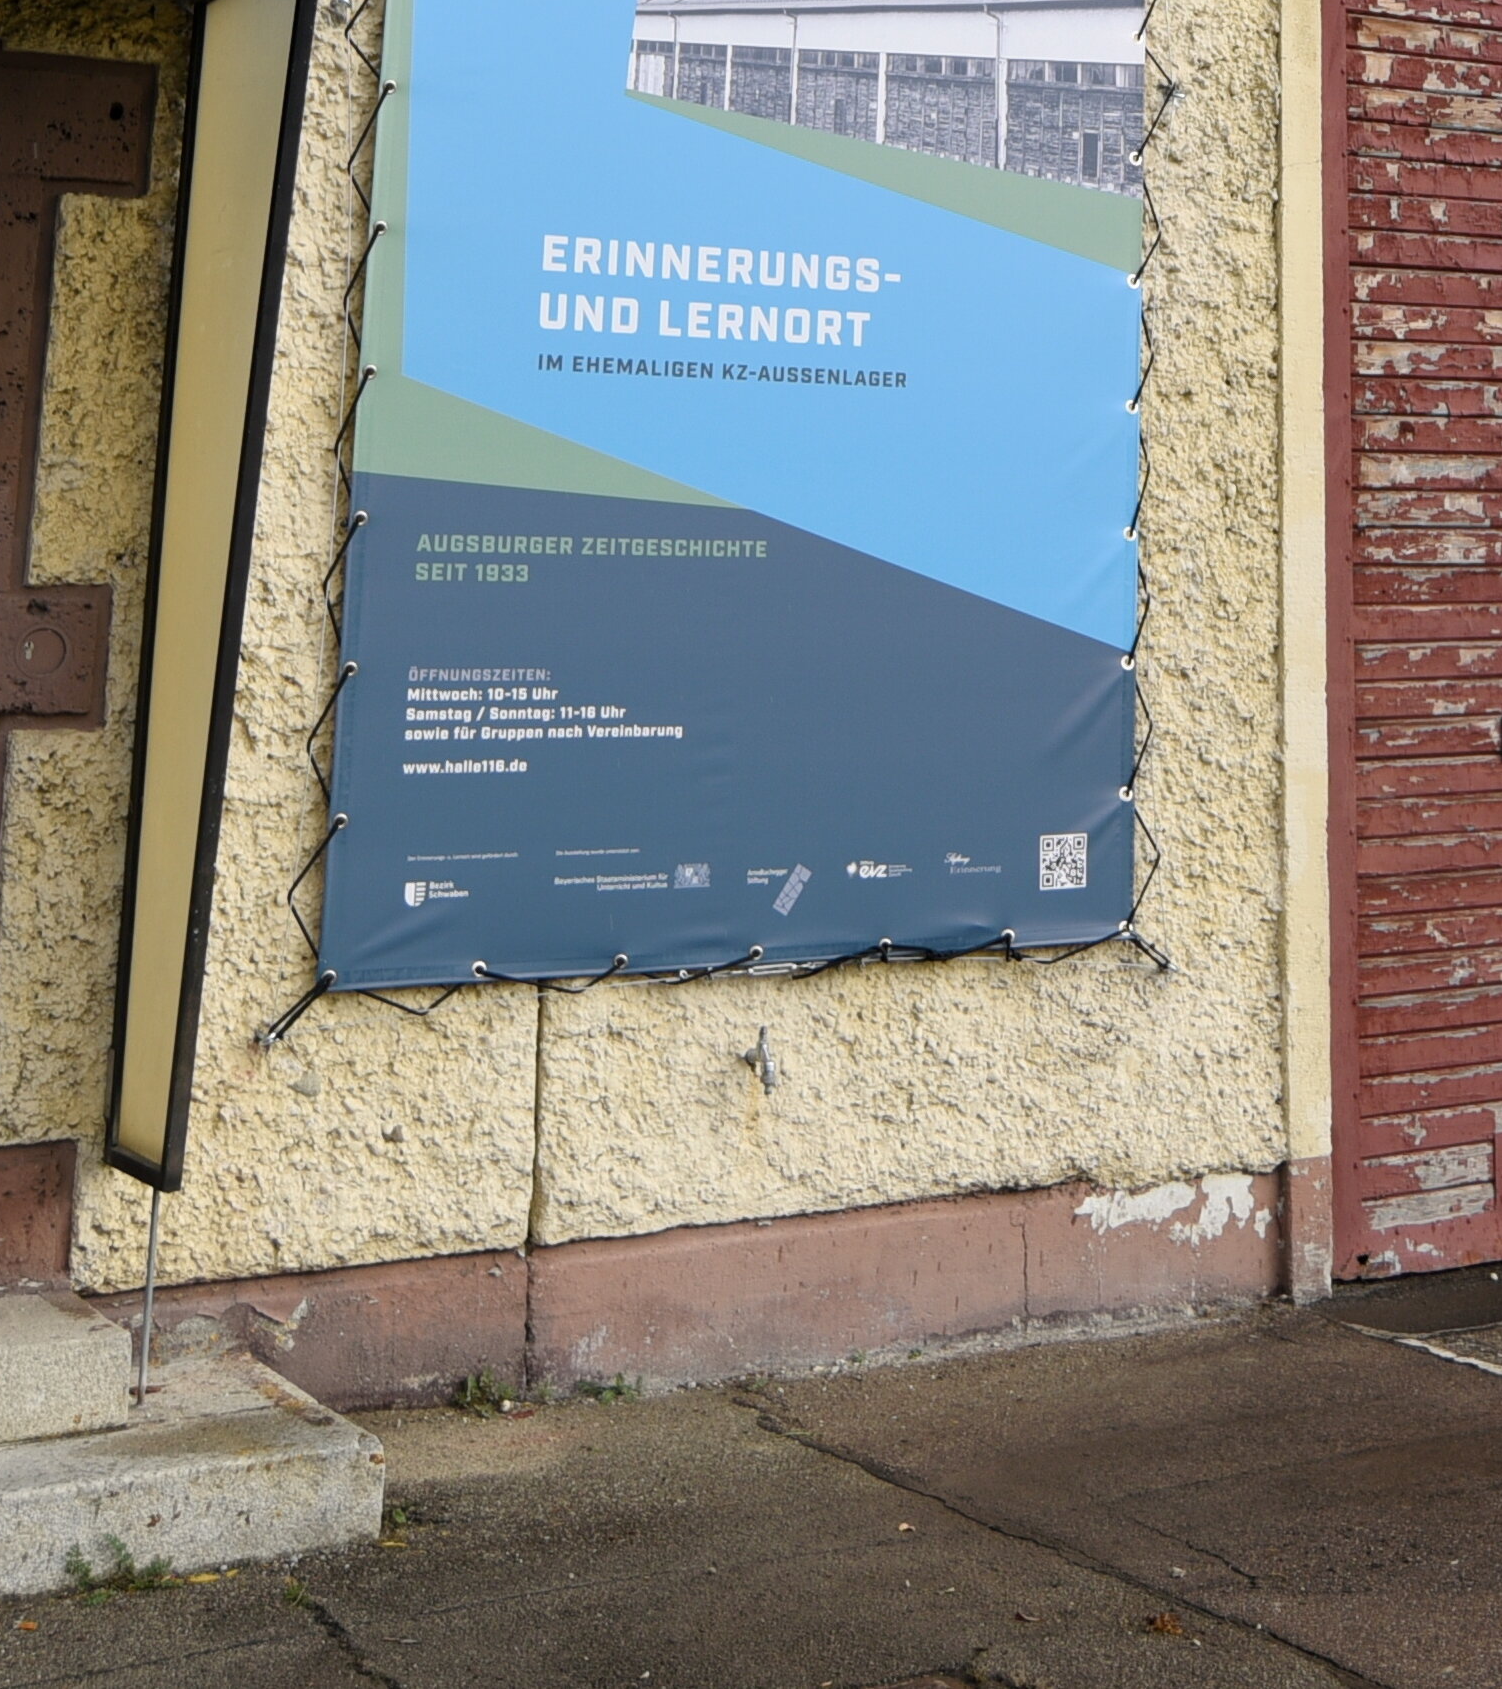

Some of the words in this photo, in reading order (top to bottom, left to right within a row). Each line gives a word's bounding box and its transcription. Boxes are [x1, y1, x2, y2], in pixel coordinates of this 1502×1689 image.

[542, 234, 901, 293] ERINNERUNGS-
[539, 292, 639, 334] UND
[659, 300, 871, 347] LERNORT
[538, 353, 563, 372] IM
[572, 356, 714, 379] EHEMALIGEN
[722, 364, 907, 388] KZ-AUSSENLAGER
[416, 534, 573, 555] AUGSBURGER
[581, 537, 768, 558] ZEITGESCHICHTE
[415, 563, 467, 582] SEIT
[475, 563, 529, 582] 1933
[408, 666, 551, 682] ÖFFNUNGSZEITEN:
[407, 688, 482, 701] Mittwoch:
[488, 688, 527, 701] 10-15
[532, 687, 559, 701] Uhr
[406, 708, 471, 722] Samstag
[476, 707, 485, 723] /
[489, 707, 555, 722] Sonntag:
[560, 706, 596, 720] 11-16
[601, 706, 626, 719] Uhr
[405, 727, 449, 741] sowie
[454, 726, 476, 740] für
[481, 726, 543, 741] Gruppen
[548, 725, 582, 738] nach
[587, 725, 683, 739] Vereinbarung
[403, 760, 527, 774] www.halle116.de
[428, 890, 469, 899] Schwaben
